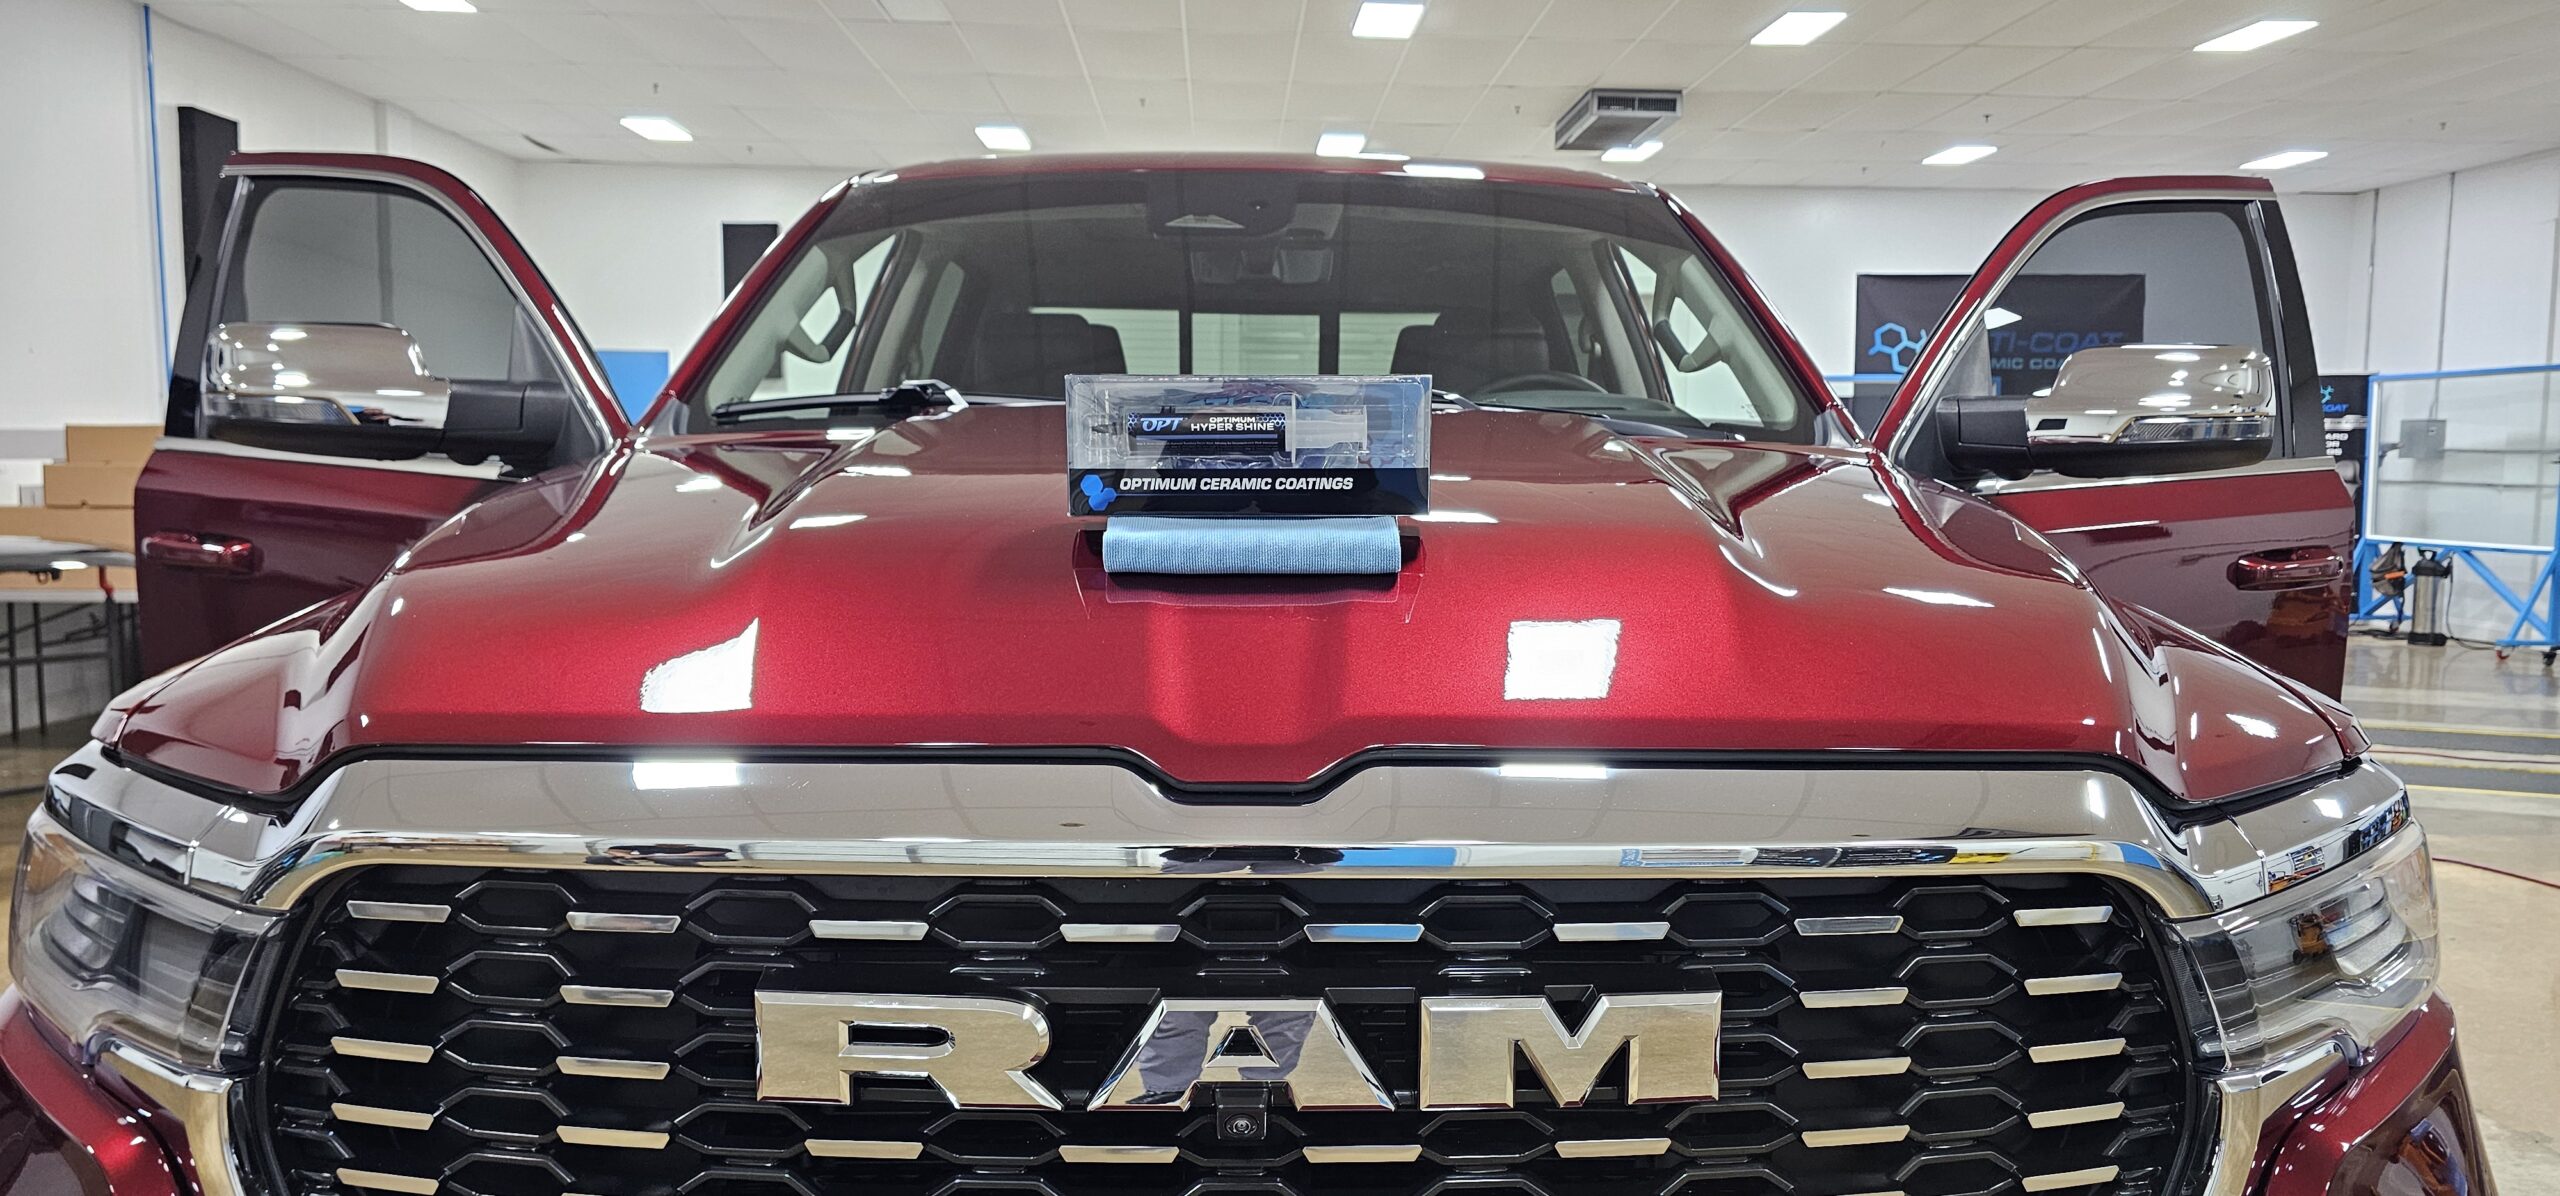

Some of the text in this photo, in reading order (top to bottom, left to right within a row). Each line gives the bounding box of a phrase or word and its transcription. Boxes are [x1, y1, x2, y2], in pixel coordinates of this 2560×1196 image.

[1989, 331, 2124, 353] TI-COAT
[1140, 417, 1184, 432] OPT
[1190, 422, 1275, 432] HYPER SHINE
[1119, 477, 1354, 491] OPTIMUM CERAMIC COATINGS
[755, 989, 1722, 1111] RAM
